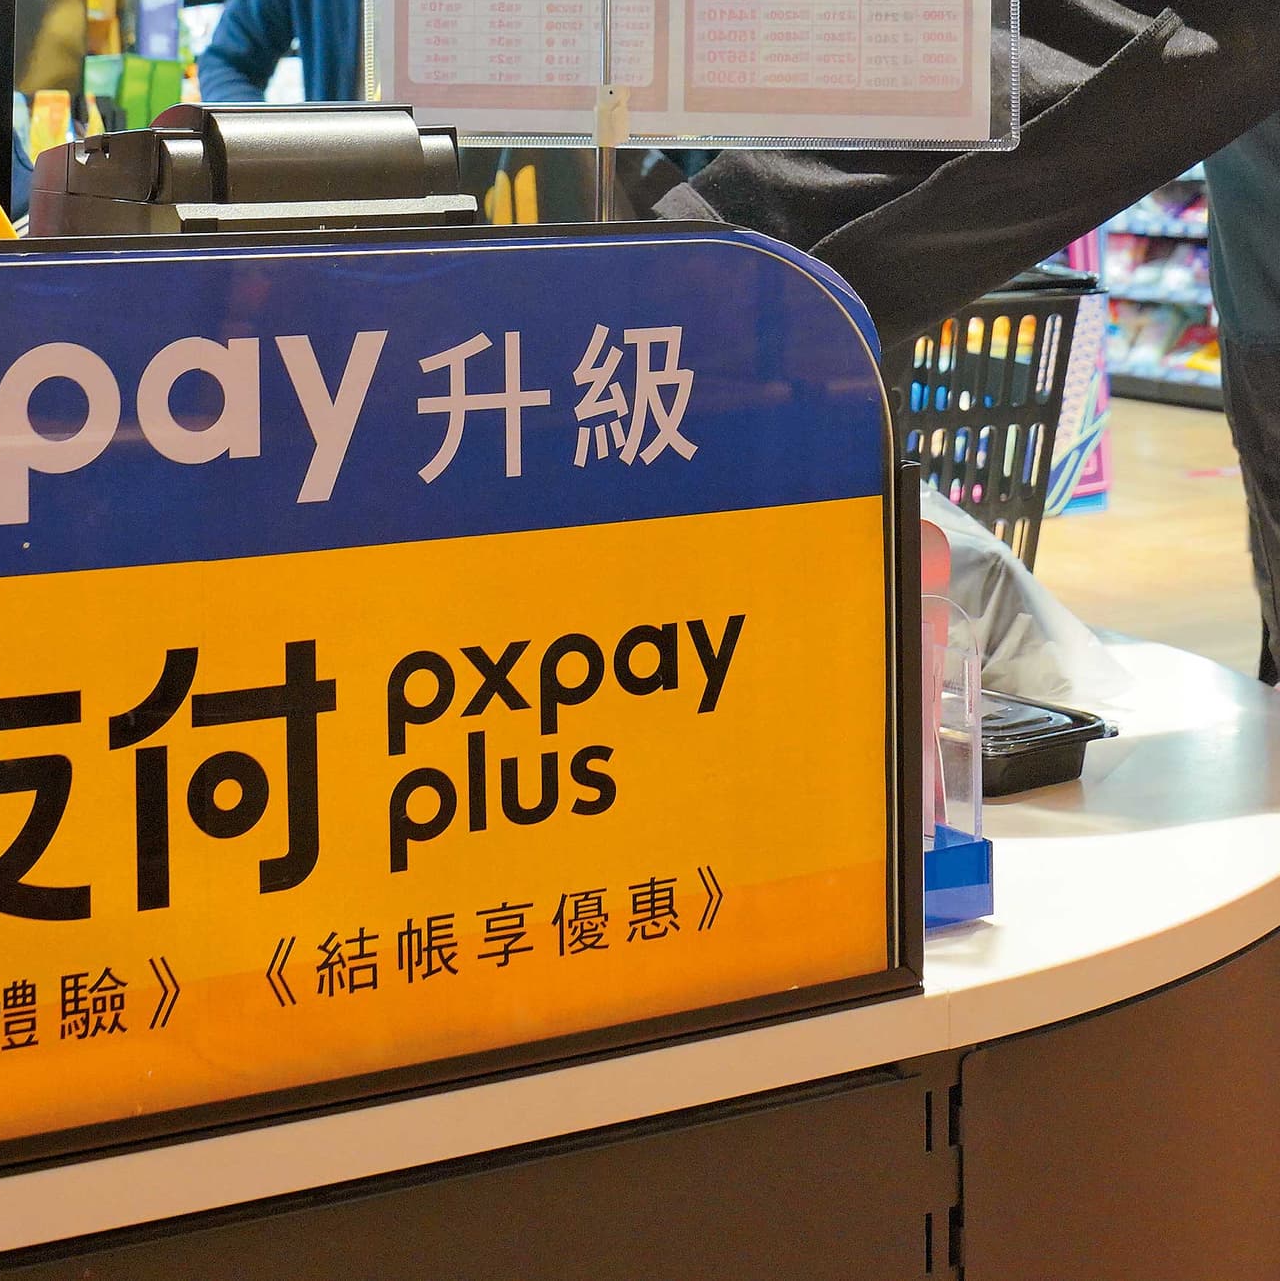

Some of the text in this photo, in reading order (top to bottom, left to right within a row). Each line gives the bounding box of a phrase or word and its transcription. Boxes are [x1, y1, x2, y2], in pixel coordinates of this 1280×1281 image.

[417, 324, 699, 484] 升級
[387, 614, 747, 757] pxpay
[389, 731, 617, 874] plus
[264, 865, 725, 1008] 《結帳享優惠》
